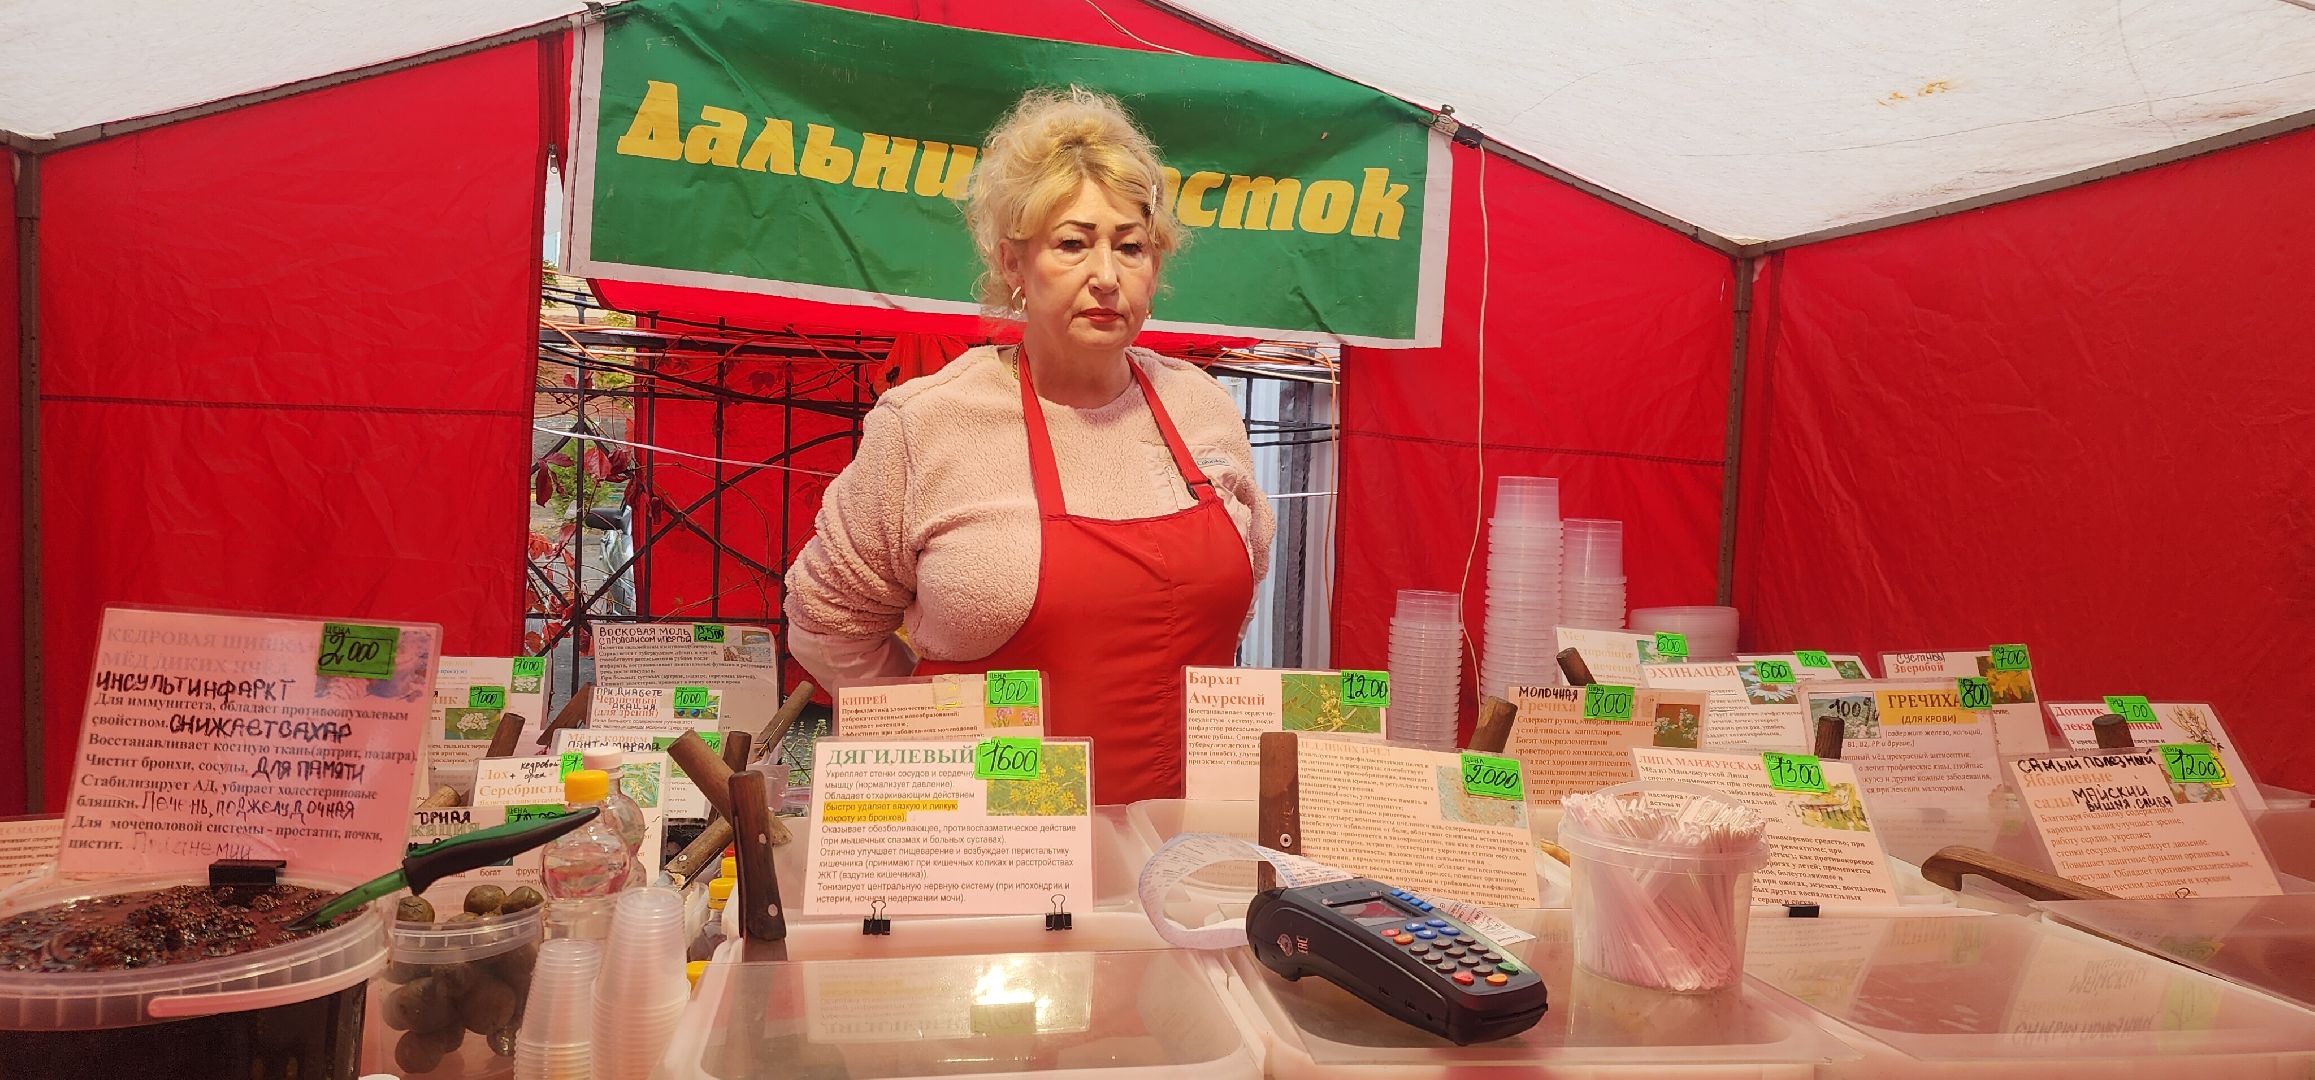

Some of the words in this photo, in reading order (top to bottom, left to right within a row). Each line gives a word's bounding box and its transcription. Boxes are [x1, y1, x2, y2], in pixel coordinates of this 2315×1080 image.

[616, 80, 977, 200] Дальни
[107, 627, 216, 648] КЕДРОВАЯ
[600, 626, 656, 636] ВОСКОВАЯ
[658, 627, 690, 636] МОЛЬ
[1760, 662, 1787, 679] 600
[1894, 664, 1944, 675] Зверобой
[1189, 671, 1242, 687] Бархат
[1346, 674, 1387, 700] 1200
[596, 688, 613, 696] ПРИ
[614, 687, 663, 697] ДИАБЕТЕ
[677, 692, 700, 704] 1000
[990, 677, 1028, 704] 900
[1519, 686, 1578, 702] МОЛОЧНАЯ
[94, 693, 123, 705] Для
[220, 700, 276, 714] обладает
[282, 705, 408, 721] противоопухолевым
[612, 703, 656, 711] АКАЦИЯ
[842, 695, 888, 706] КИПРЕЙ
[1189, 692, 1266, 708] Амурский
[1519, 700, 1576, 714] Гречиха
[1592, 692, 1626, 716] 800
[1902, 715, 1923, 724] (ДЛЯ
[1926, 715, 1957, 723] КРОВИ)
[2055, 706, 2105, 717] Донник
[89, 733, 210, 750] Восстанавливает
[213, 743, 270, 756] костную
[86, 753, 138, 767] Чистит
[826, 745, 976, 768] ДЯГИЛЕВЫЙ
[983, 741, 1037, 772] 1600
[1639, 755, 1673, 764] ЛИПА
[1676, 758, 1762, 771] МАНЖУРСКАЯ
[2018, 755, 2082, 774] САМЫЙ
[2084, 748, 2157, 769] ПОЛЕЗНЫЙ
[2171, 749, 2218, 780] 1200
[252, 756, 291, 782] ДЛЯ
[298, 760, 365, 785] ПАМЯТИ
[826, 770, 867, 779] Укрепляет
[1465, 765, 1518, 788] 2000
[1771, 757, 1821, 787] 1300
[81, 773, 189, 791] Стабилизирует
[222, 782, 273, 795] убирает
[278, 784, 378, 800] холестериновые
[2023, 772, 2113, 788] Яблоневые
[824, 792, 864, 800] Обладает
[866, 792, 930, 800] отхаркивающим
[858, 803, 890, 811] удаляет
[72, 815, 102, 828] Для
[110, 818, 203, 832] мочеполовой
[206, 822, 264, 835] системы
[822, 814, 855, 823] мокроту
[822, 825, 865, 833] Оказывает
[943, 824, 1038, 833] противоспазматическое
[1040, 824, 1076, 833] действие
[821, 837, 838, 846] (при
[820, 848, 855, 856] Отлично
[857, 848, 896, 857] улучшает
[899, 848, 953, 856] пищеварение
[964, 847, 1009, 856] возбуждает
[1011, 847, 1069, 856] перистальтику
[866, 860, 913, 868] (принимают
[1016, 859, 1073, 868] расстройствах
[479, 869, 502, 877] богат
[818, 871, 837, 879] ЖКТ
[839, 871, 874, 880] (вздутие
[817, 883, 865, 892] Тонизирует
[867, 882, 921, 891] центральную
[924, 882, 959, 892] нервную
[961, 882, 994, 890] систему
[1016, 882, 1063, 890] ипохондрии
